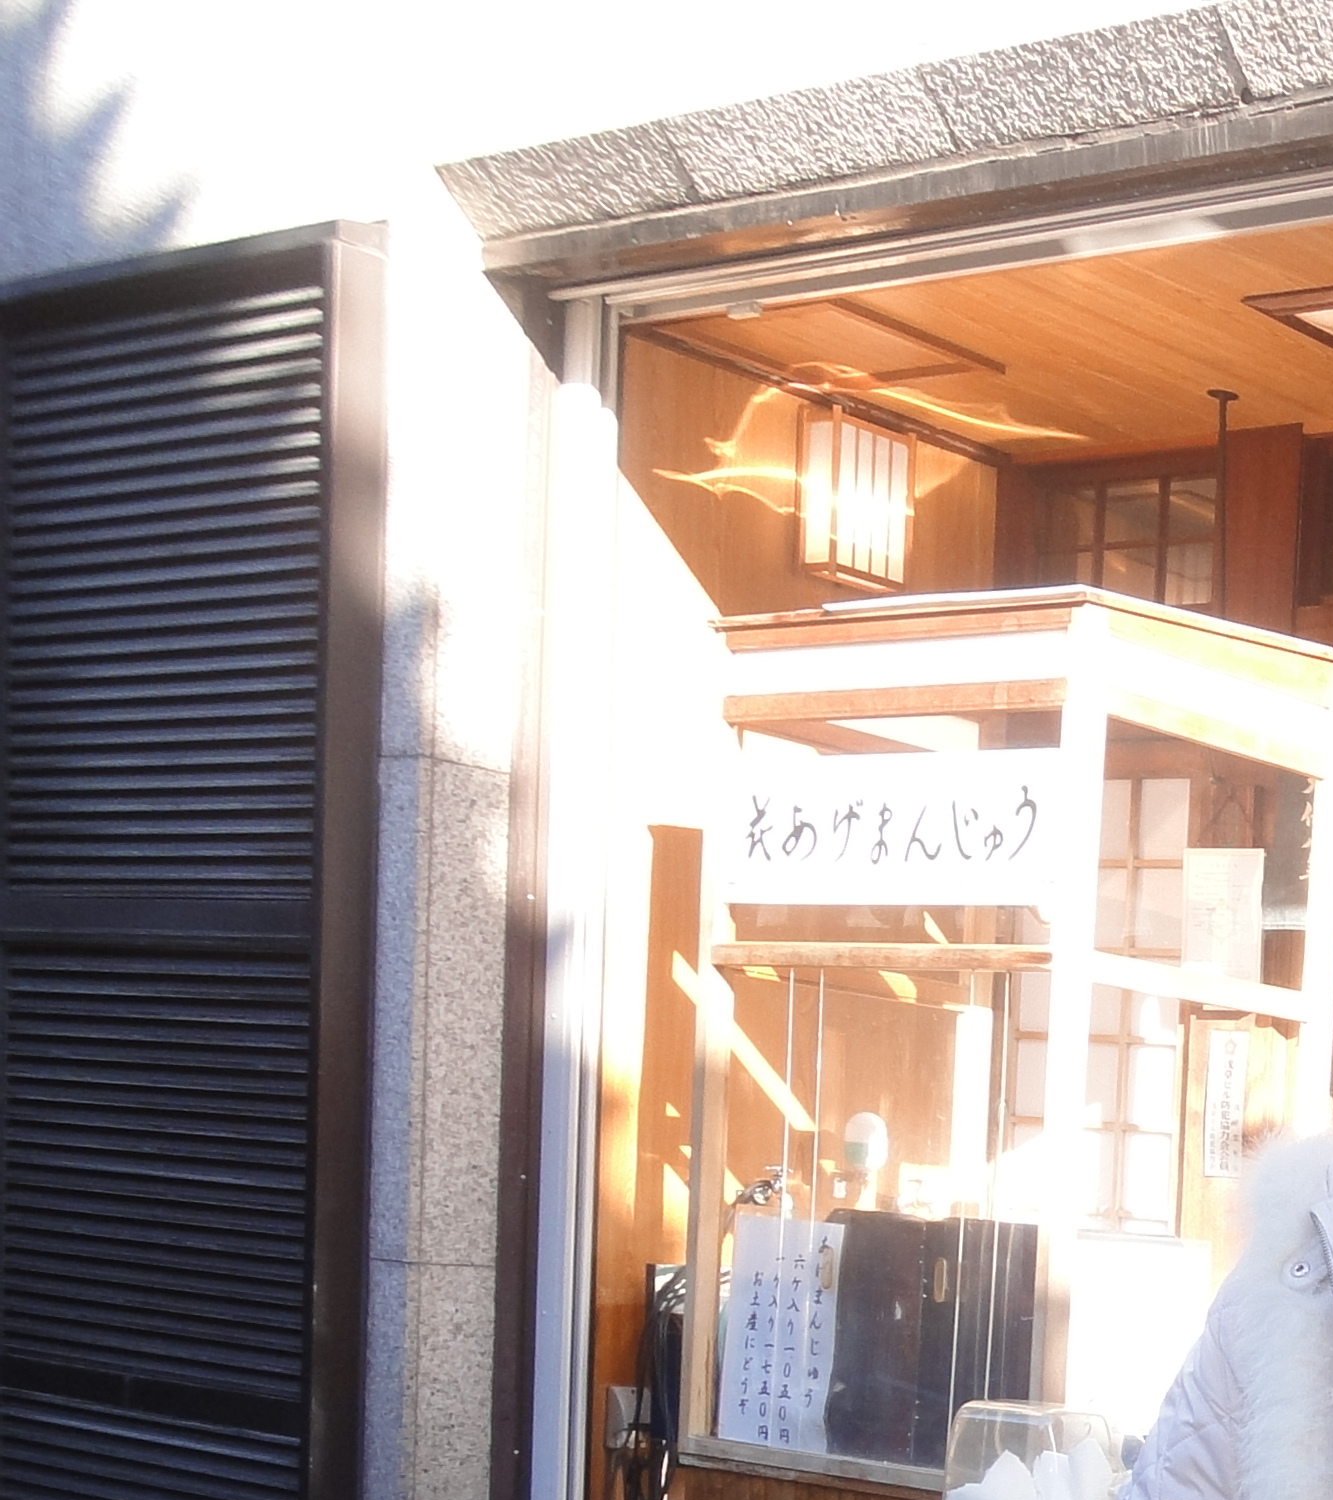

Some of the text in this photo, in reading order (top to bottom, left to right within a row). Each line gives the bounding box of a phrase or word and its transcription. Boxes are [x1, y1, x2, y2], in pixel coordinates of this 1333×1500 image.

[738, 1271, 764, 1416] お土産にどうぞ
